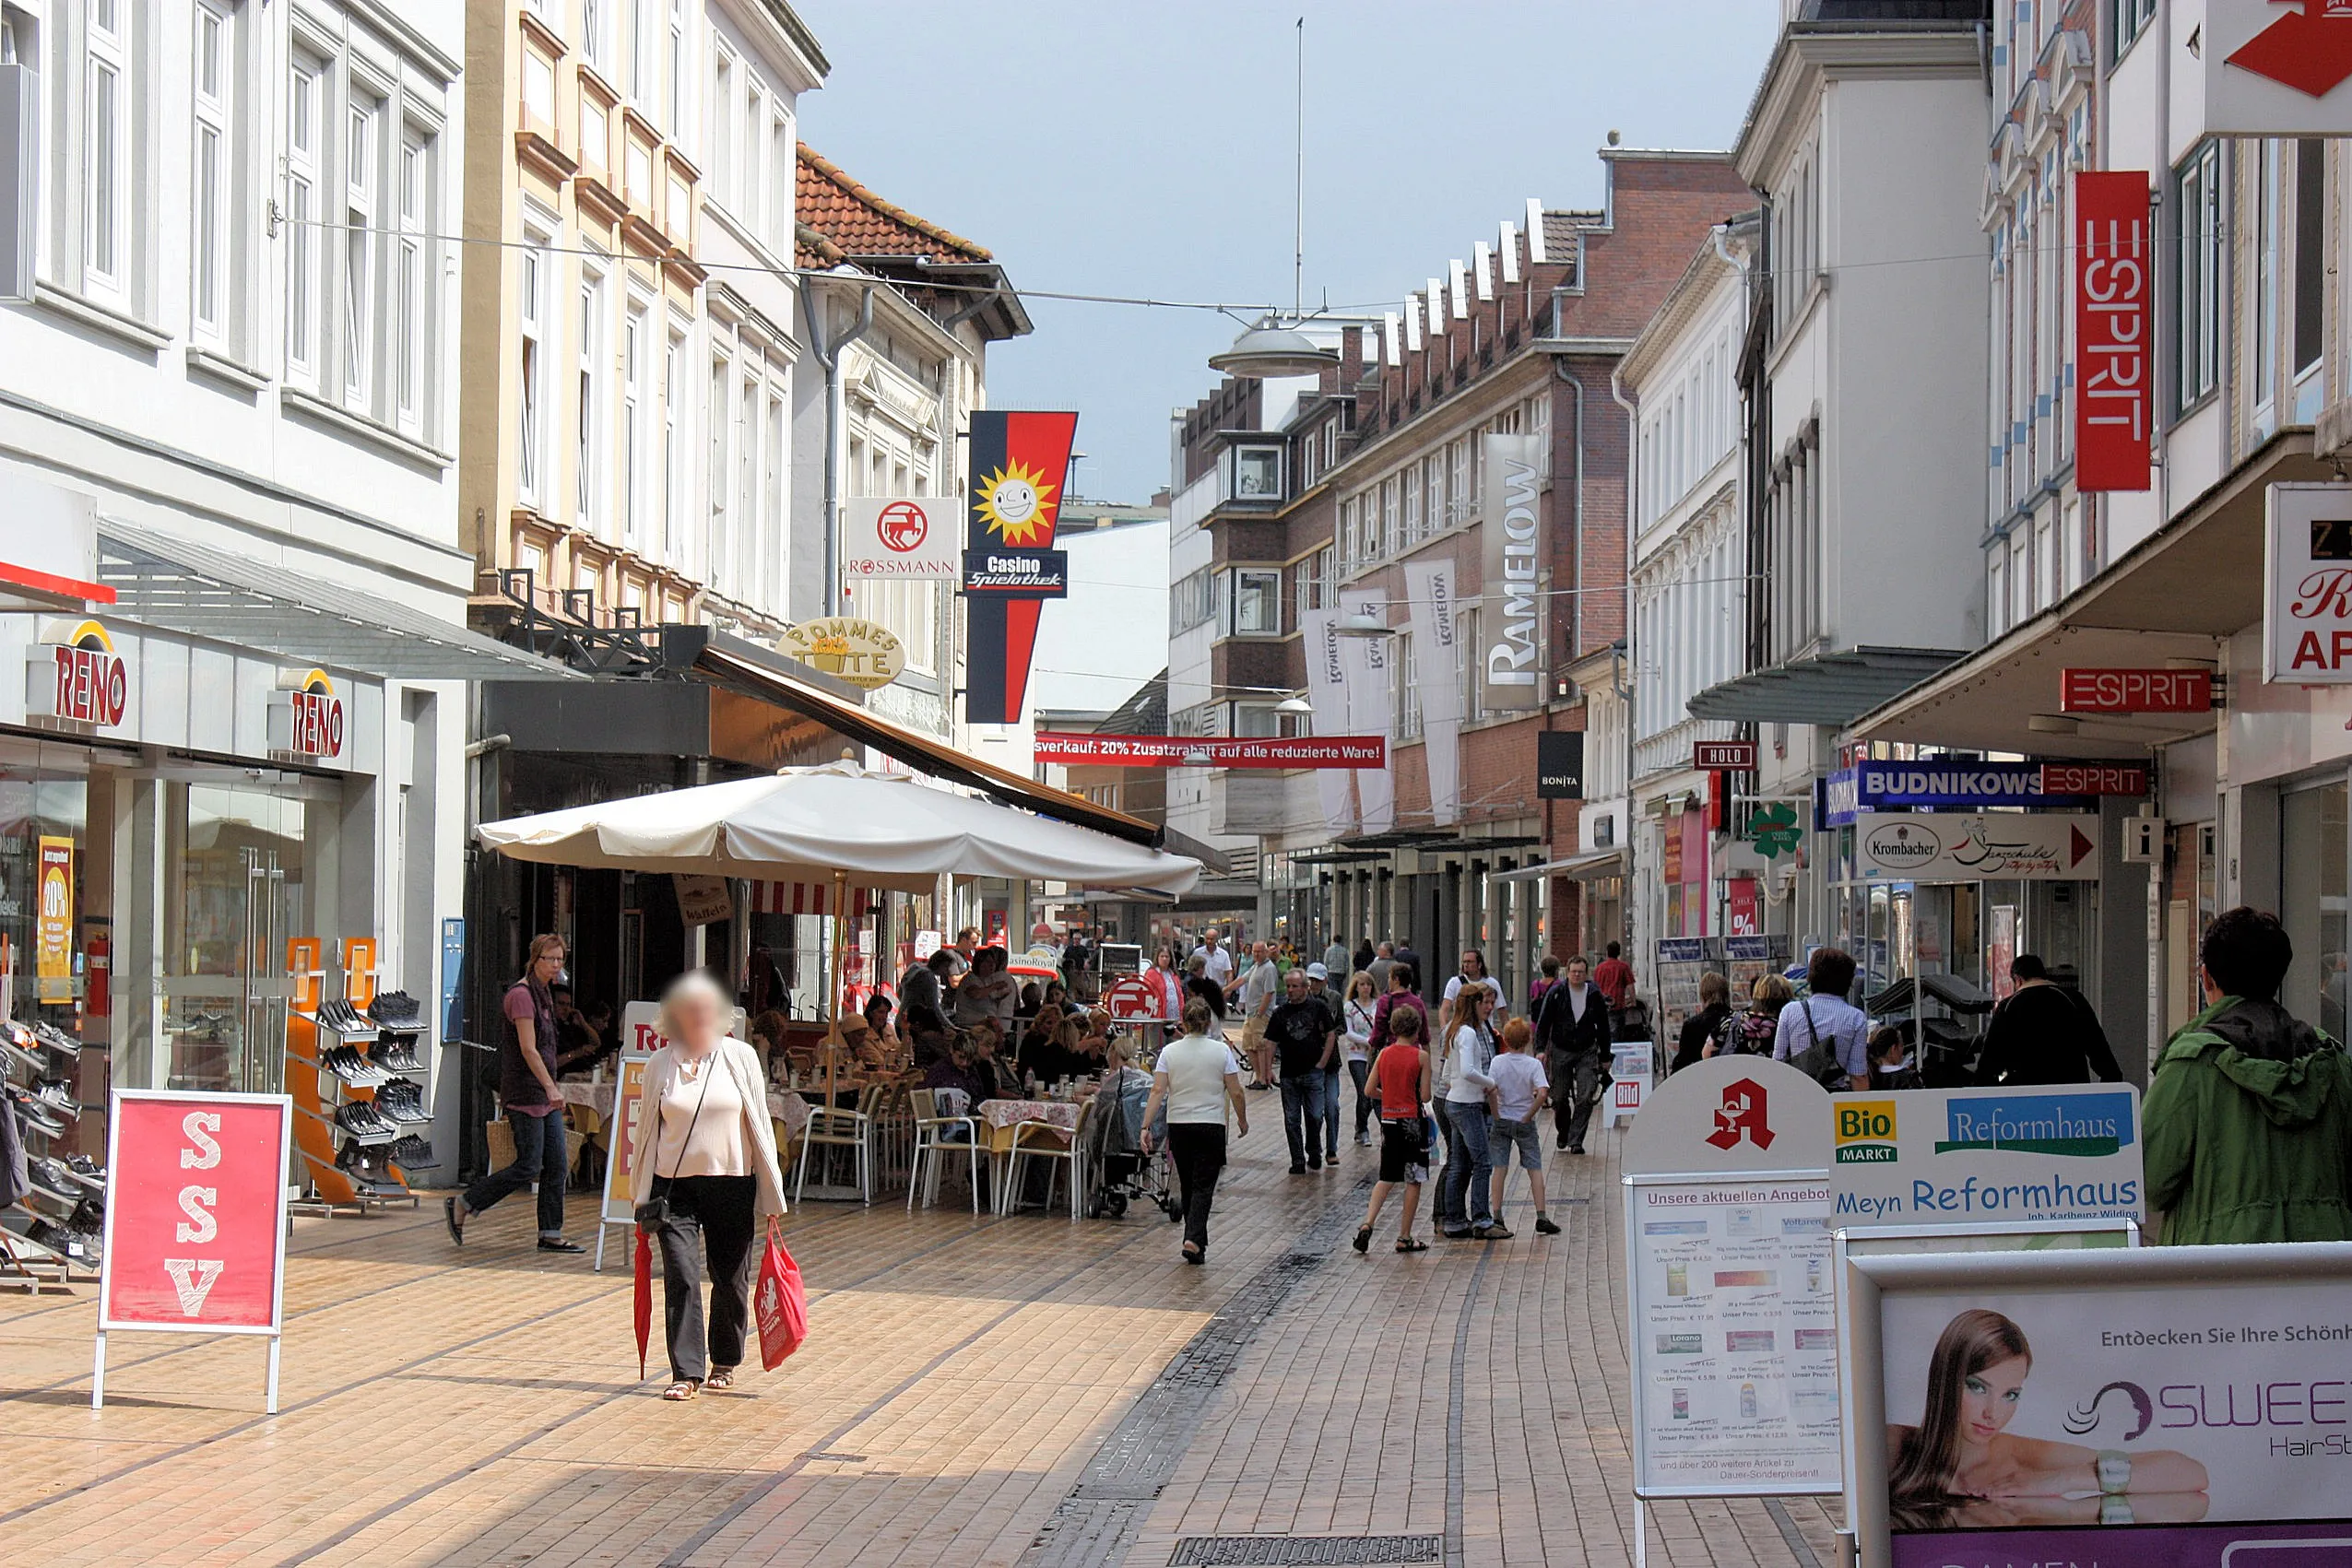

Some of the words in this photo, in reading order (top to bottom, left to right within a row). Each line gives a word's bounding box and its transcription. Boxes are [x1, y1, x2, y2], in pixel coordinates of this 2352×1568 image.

[2085, 219, 2141, 442] ESPRIT
[849, 559, 955, 576] ROSSMANN
[987, 555, 1041, 573] Casino
[1488, 458, 1540, 687] RAMELOW
[967, 572, 1062, 588] Spielothek
[786, 619, 900, 652] POMMES
[55, 646, 126, 727] RENO
[2073, 673, 2202, 707] ESPRIT
[290, 690, 344, 759] RENO
[1034, 739, 1098, 754] sverkauf:
[1100, 741, 1129, 755] 20%
[1131, 742, 1216, 757] Zusatzrabatt
[1219, 744, 1241, 758] auf
[1244, 745, 1268, 758] alle
[1271, 745, 1339, 759] reduzierte
[1341, 746, 1380, 759] Ware!
[1542, 775, 1578, 787] BONITA
[1866, 772, 2042, 796] BUDNIKOWS
[2049, 767, 2141, 795] ESPRIT
[1873, 840, 1935, 856] Krombacher
[44, 880, 66, 918] 20%
[1009, 956, 1056, 969] asinoRoyal
[1617, 1084, 1638, 1104] Bild
[1840, 1109, 1891, 1138] Bio
[1954, 1105, 2117, 1150] Reformhaus
[1841, 1148, 1891, 1161] MARKT
[1648, 1193, 1697, 1206] Unsere
[1704, 1191, 1767, 1203] aktuellen
[1836, 1192, 1902, 1220] Meyn
[1912, 1173, 2137, 1212] Reformhaus
[1782, 1218, 1822, 1227] Voltaren
[2099, 1208, 2139, 1220] Wilding
[1672, 1334, 1701, 1342] Lorano
[2101, 1330, 2203, 1347] Entdecken
[2207, 1327, 2236, 1344] Sie
[2241, 1326, 2279, 1343] Ihre
[2159, 1381, 2352, 1429] SWEE
[1679, 1460, 1699, 1469] über
[1701, 1460, 1719, 1468] 200
[1720, 1459, 1752, 1468] weitere
[1754, 1458, 1781, 1468] Artikel
